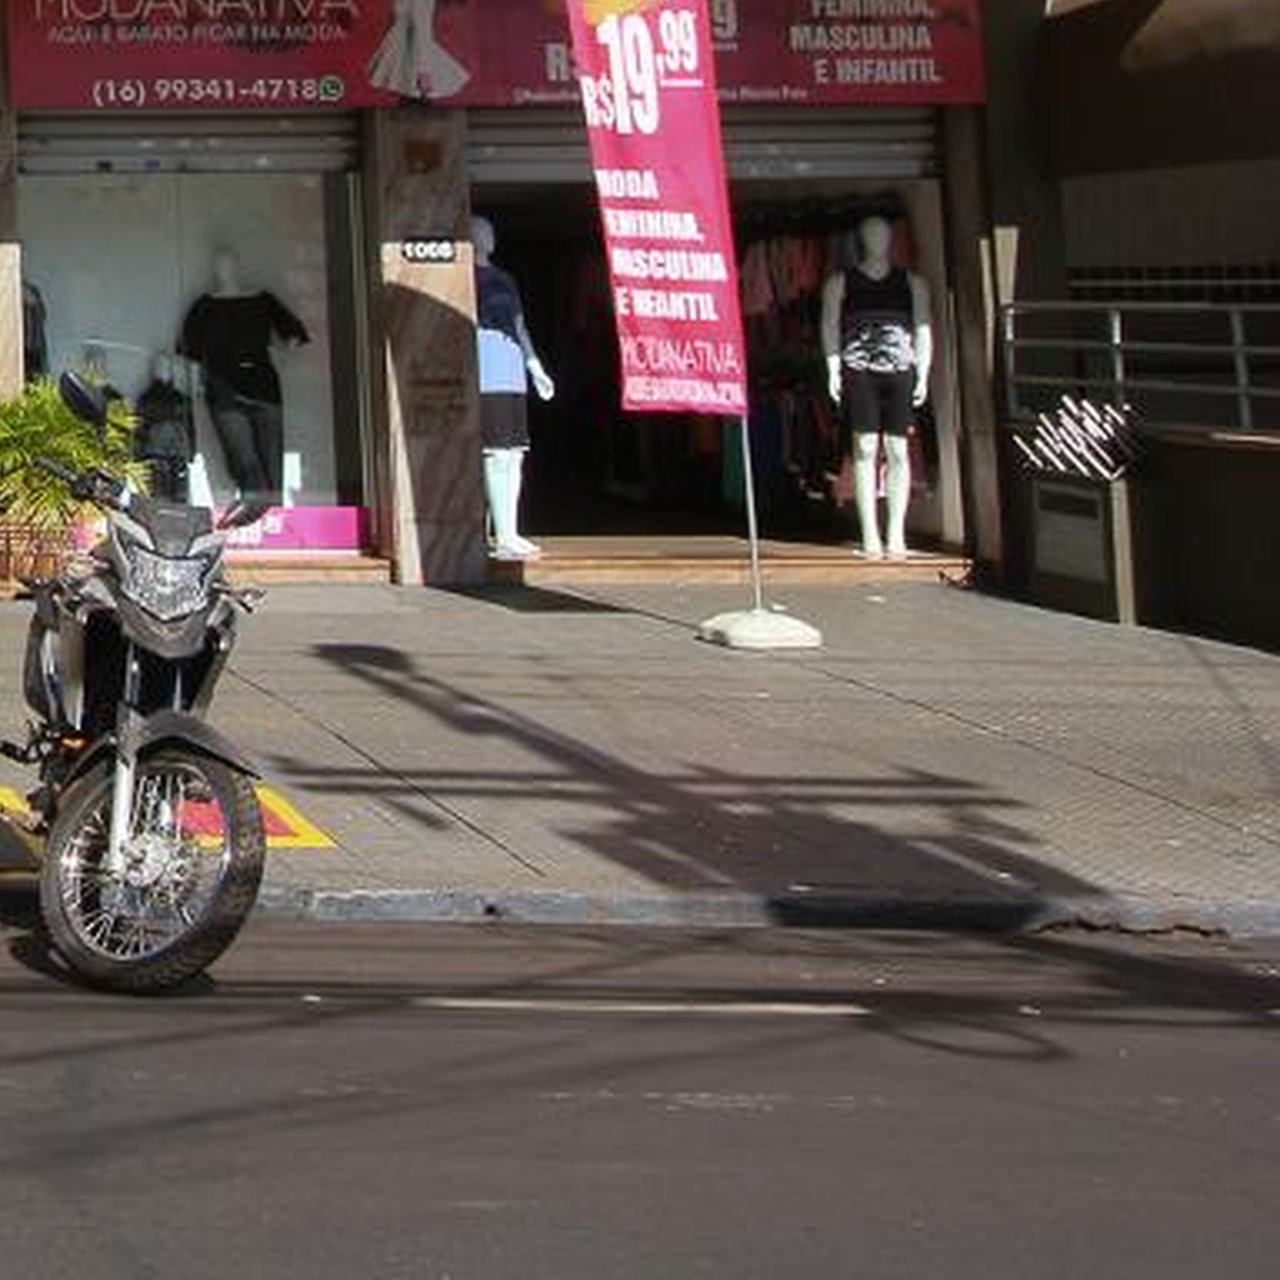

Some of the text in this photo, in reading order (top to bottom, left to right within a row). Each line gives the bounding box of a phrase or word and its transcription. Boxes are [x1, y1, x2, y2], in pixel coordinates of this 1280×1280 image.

[284, 23, 347, 40] MODA
[789, 24, 933, 52] MASCULINA
[813, 58, 942, 84] E INFANTIL
[92, 78, 318, 107] (16) 99341-4718
[593, 169, 660, 200] MODA
[614, 287, 631, 316] E
